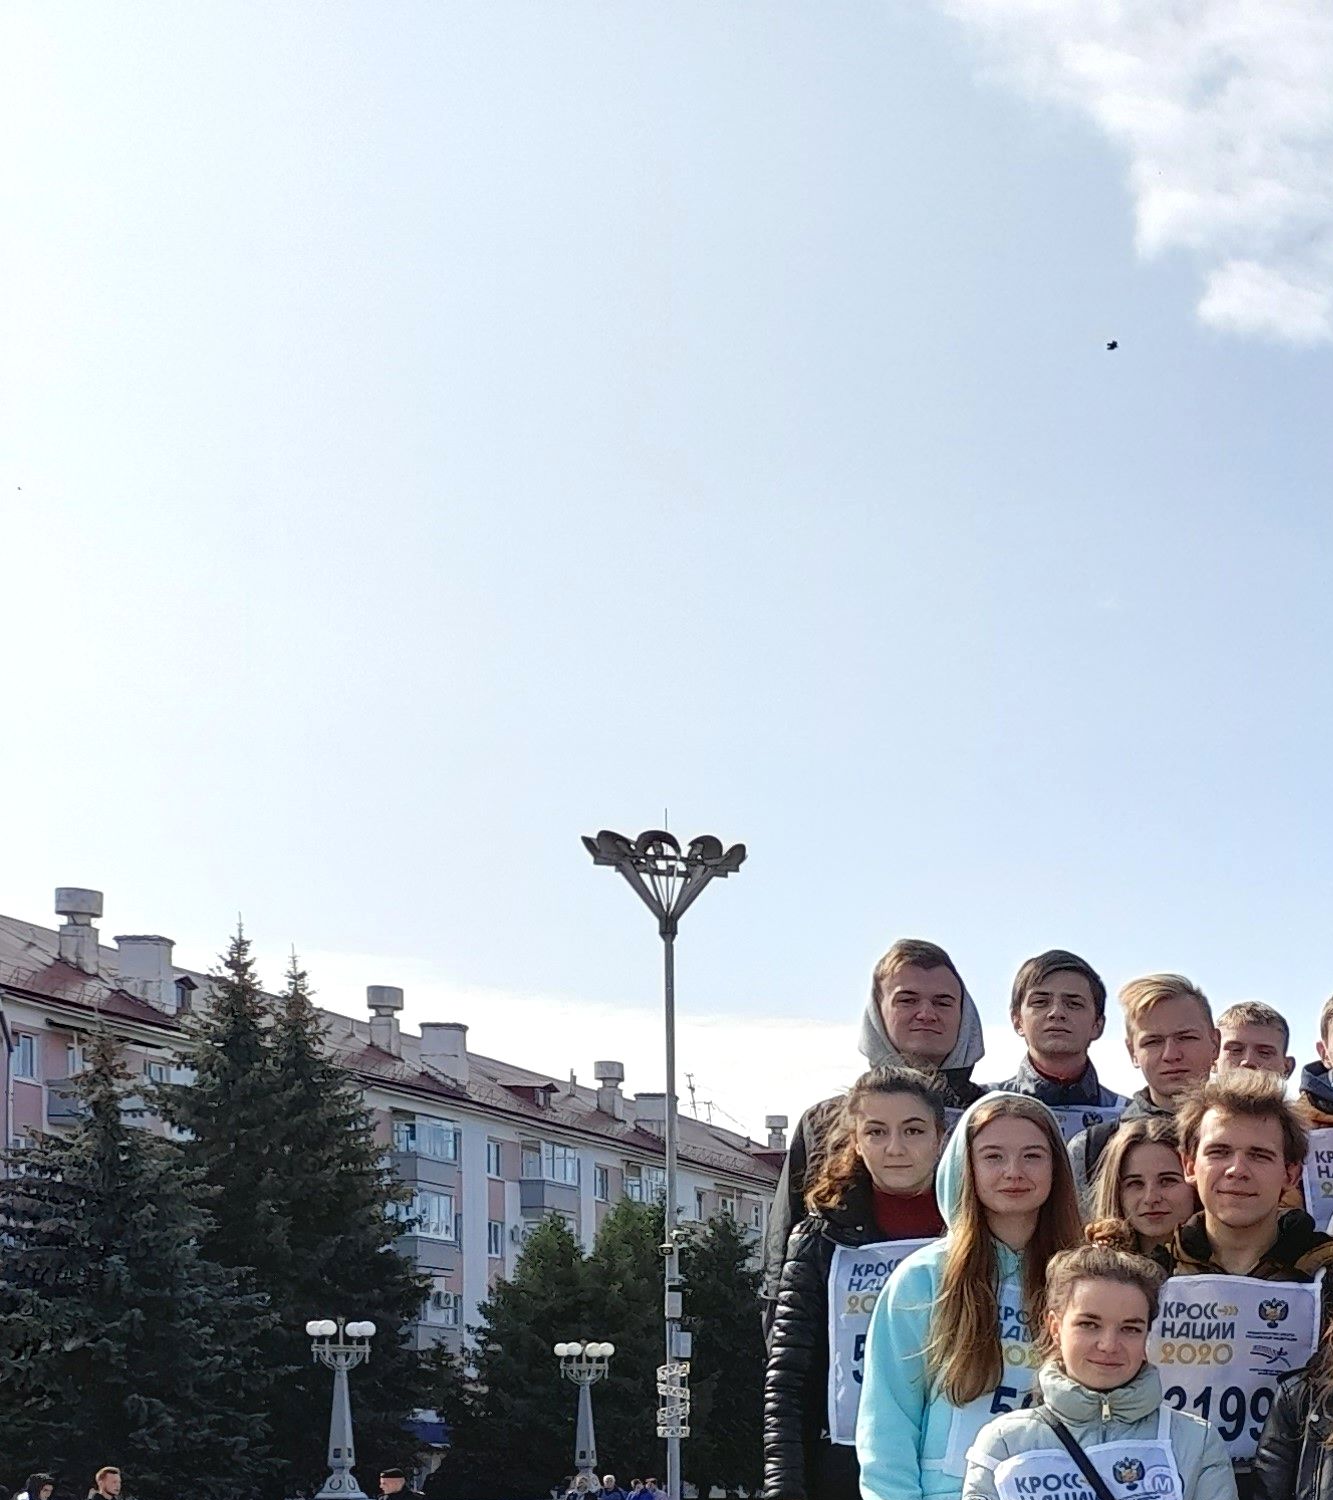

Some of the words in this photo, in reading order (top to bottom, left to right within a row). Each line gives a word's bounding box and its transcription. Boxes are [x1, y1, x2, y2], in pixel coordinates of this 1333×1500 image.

[1162, 1301, 1218, 1319] КРОСС
[1161, 1321, 1235, 1341] НАЦИИ
[1159, 1342, 1234, 1365] 2020
[1014, 1473, 1079, 1494] КРОСС
